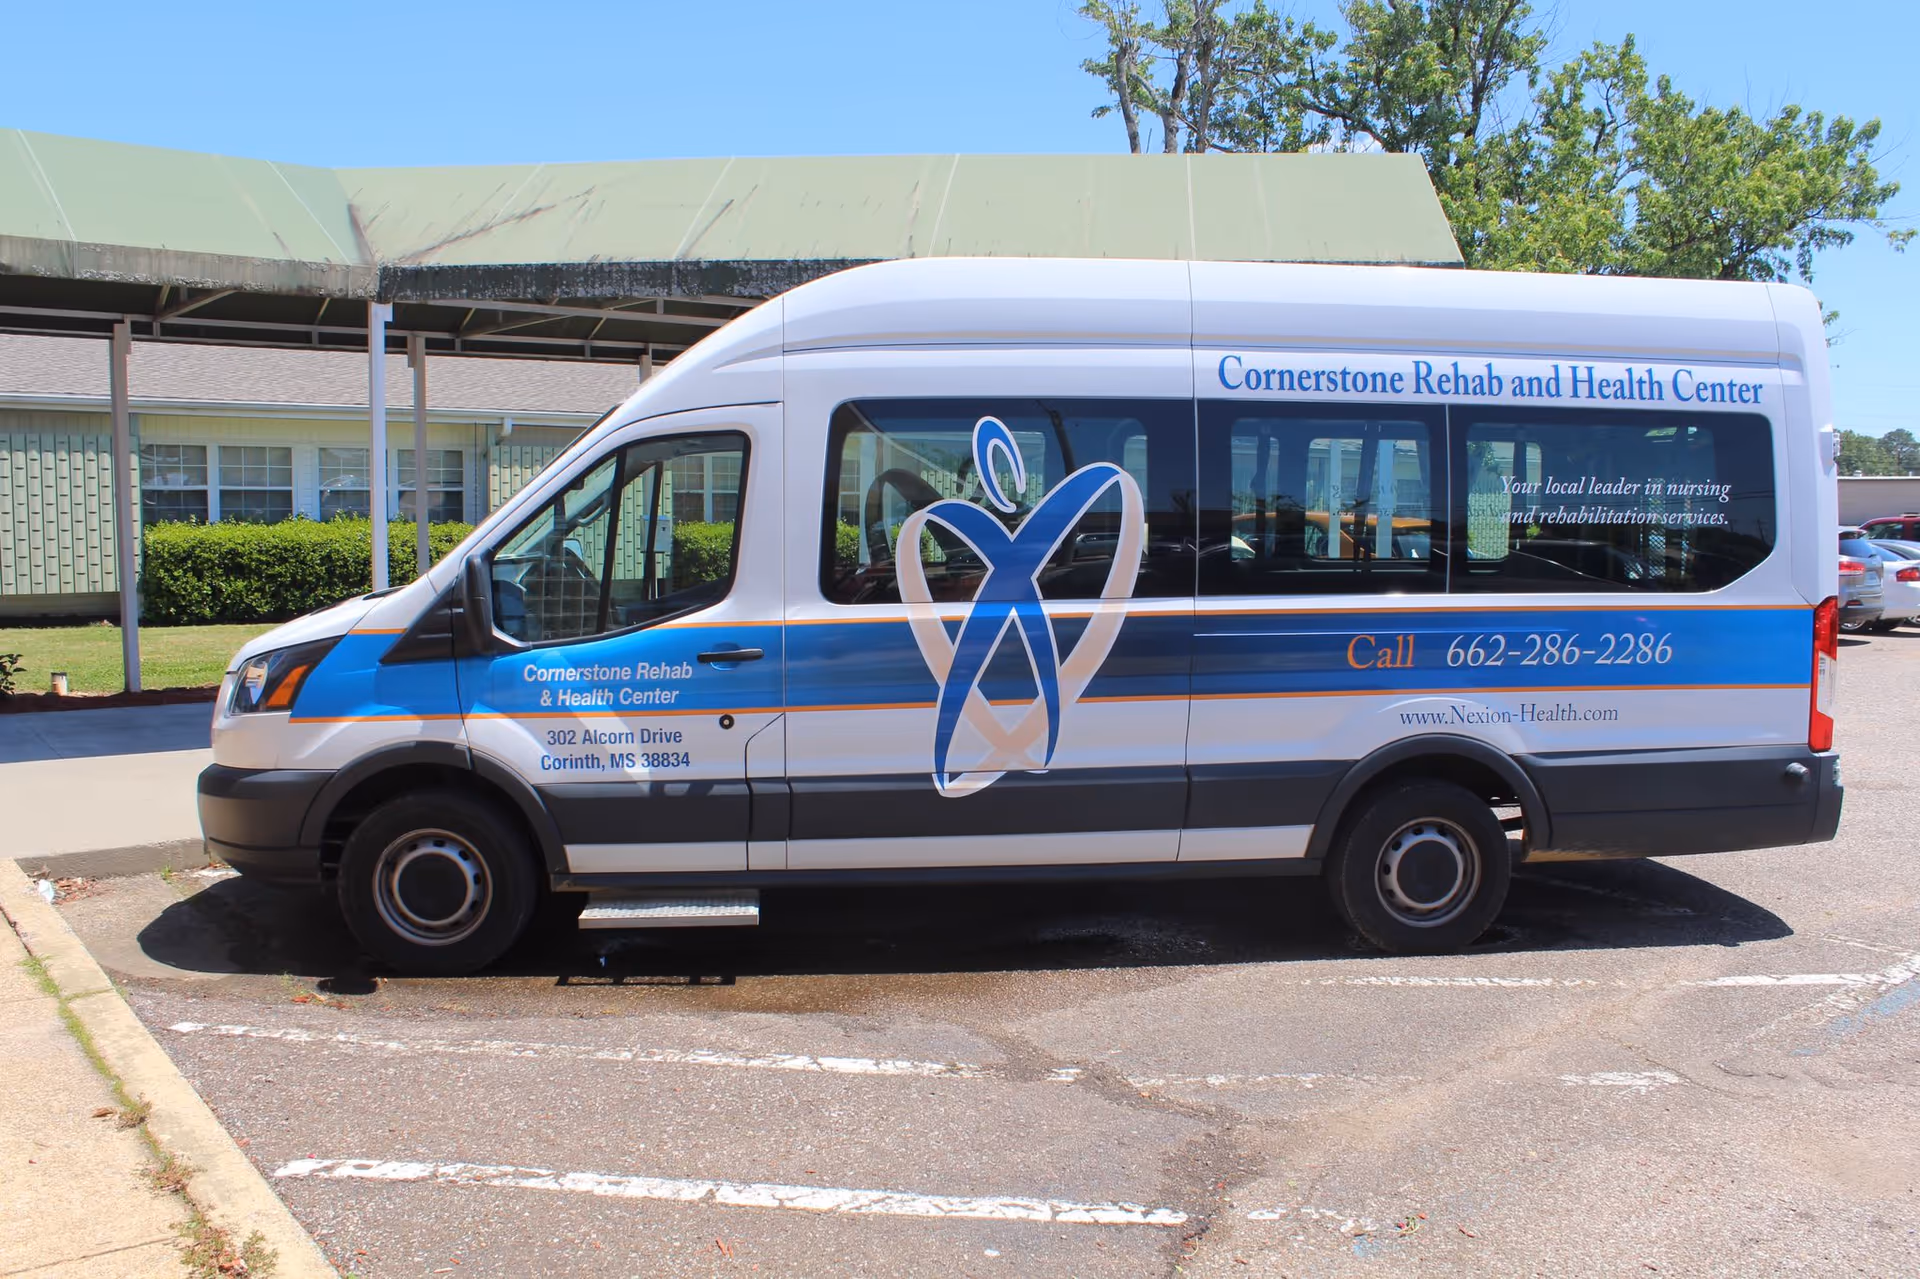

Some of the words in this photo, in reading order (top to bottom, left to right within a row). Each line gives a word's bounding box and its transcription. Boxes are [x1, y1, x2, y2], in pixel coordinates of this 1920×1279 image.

[1218, 355, 1405, 394] Cornerstone
[1412, 360, 1502, 397] Rehab
[1511, 363, 1562, 398] and
[1570, 366, 1664, 402] Health
[1671, 369, 1763, 404] Center
[1500, 475, 1541, 495] Your
[1545, 476, 1584, 495] local
[1588, 477, 1641, 495] leader
[1644, 478, 1662, 496] in
[1666, 479, 1732, 503] nursing
[1500, 506, 1535, 524] and
[1539, 506, 1658, 525] rehabilitation
[1661, 507, 1730, 525] services.
[1346, 634, 1415, 669] Call
[1446, 632, 1673, 668] 662-286-2286
[523, 664, 632, 682] Cornerstone
[636, 661, 693, 680] Rehab
[540, 689, 552, 706] &
[557, 688, 614, 706] Health
[619, 687, 680, 705] Center
[1400, 703, 1619, 725] www.Nexion-Health.com
[547, 729, 577, 745] 302
[582, 729, 635, 745] Alcorn
[640, 728, 683, 744] Drive
[541, 753, 605, 772] Corinth,
[610, 752, 636, 769] MS
[641, 752, 691, 768] 38834
